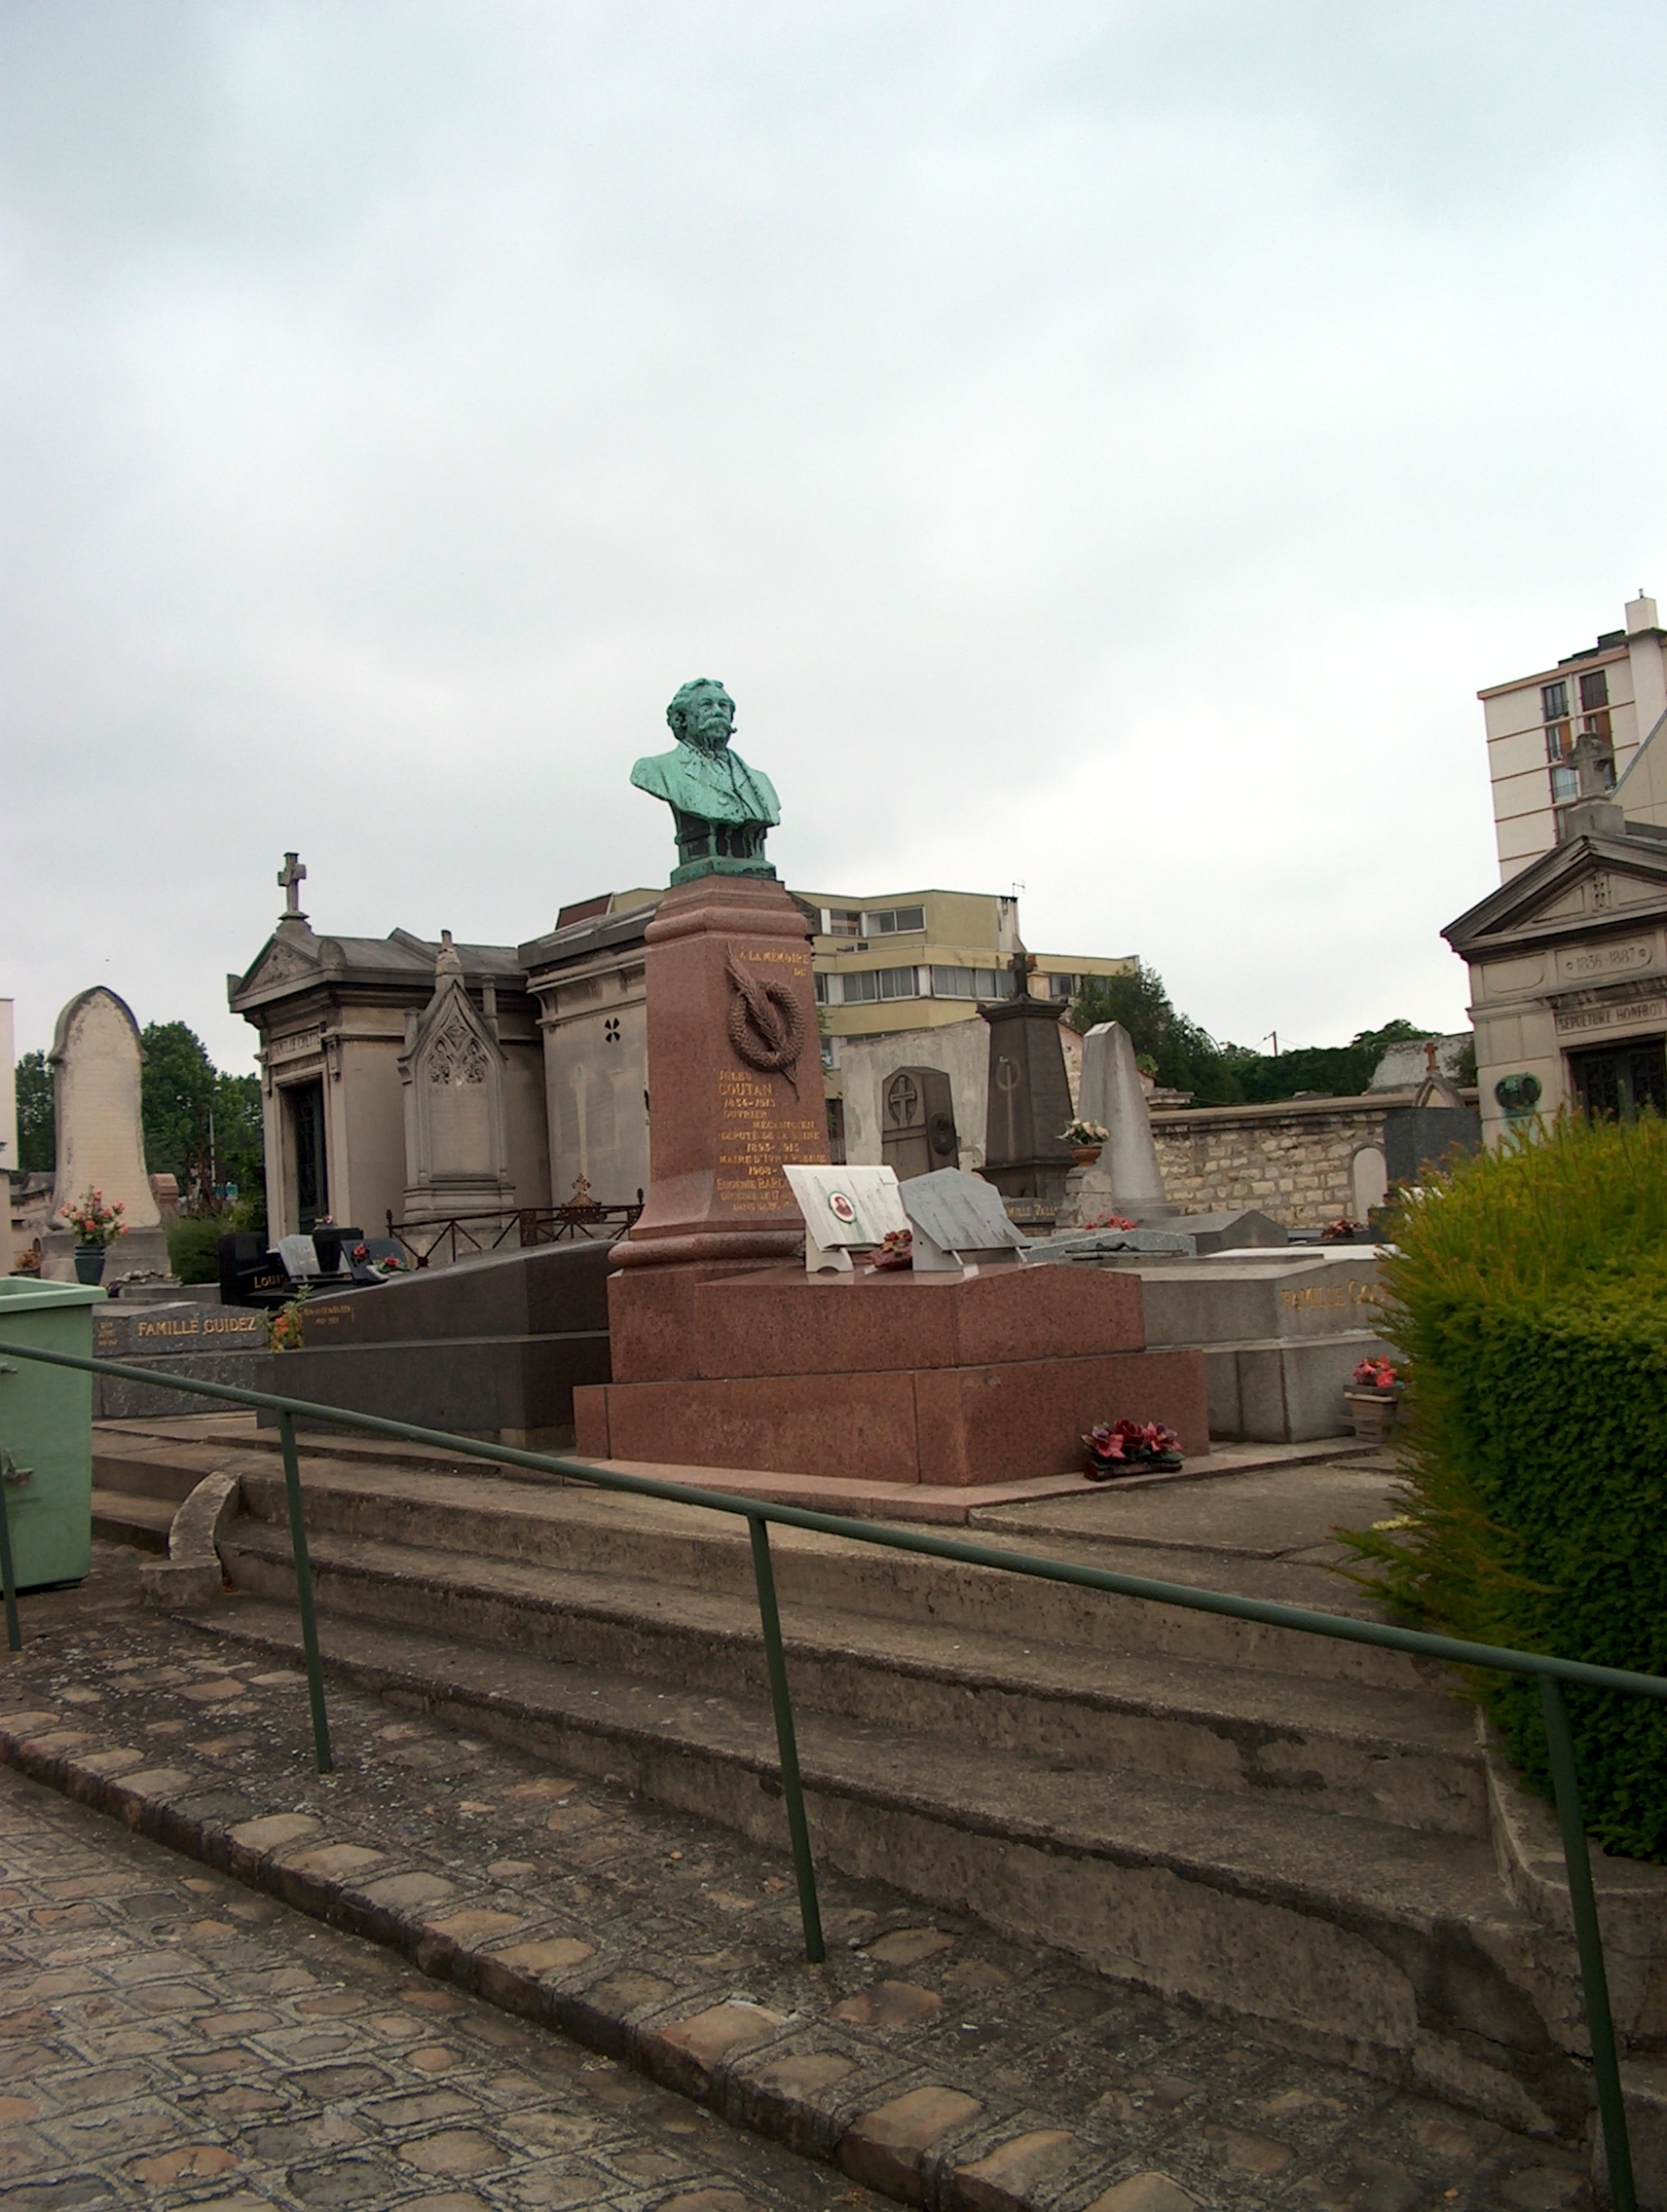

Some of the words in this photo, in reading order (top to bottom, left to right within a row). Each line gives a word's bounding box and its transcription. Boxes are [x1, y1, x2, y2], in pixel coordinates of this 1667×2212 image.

[749, 950, 761, 962] LA
[793, 968, 806, 977] DE
[720, 1071, 752, 1081] JULES
[723, 1110, 768, 1120] OUVRIER
[761, 1131, 774, 1140] DE
[720, 1155, 752, 1163] MAIRE
[1281, 1287, 1345, 1310] FAMILLE
[138, 1319, 199, 1337] FAMILLE
[203, 1316, 257, 1334] GUIDEZ
